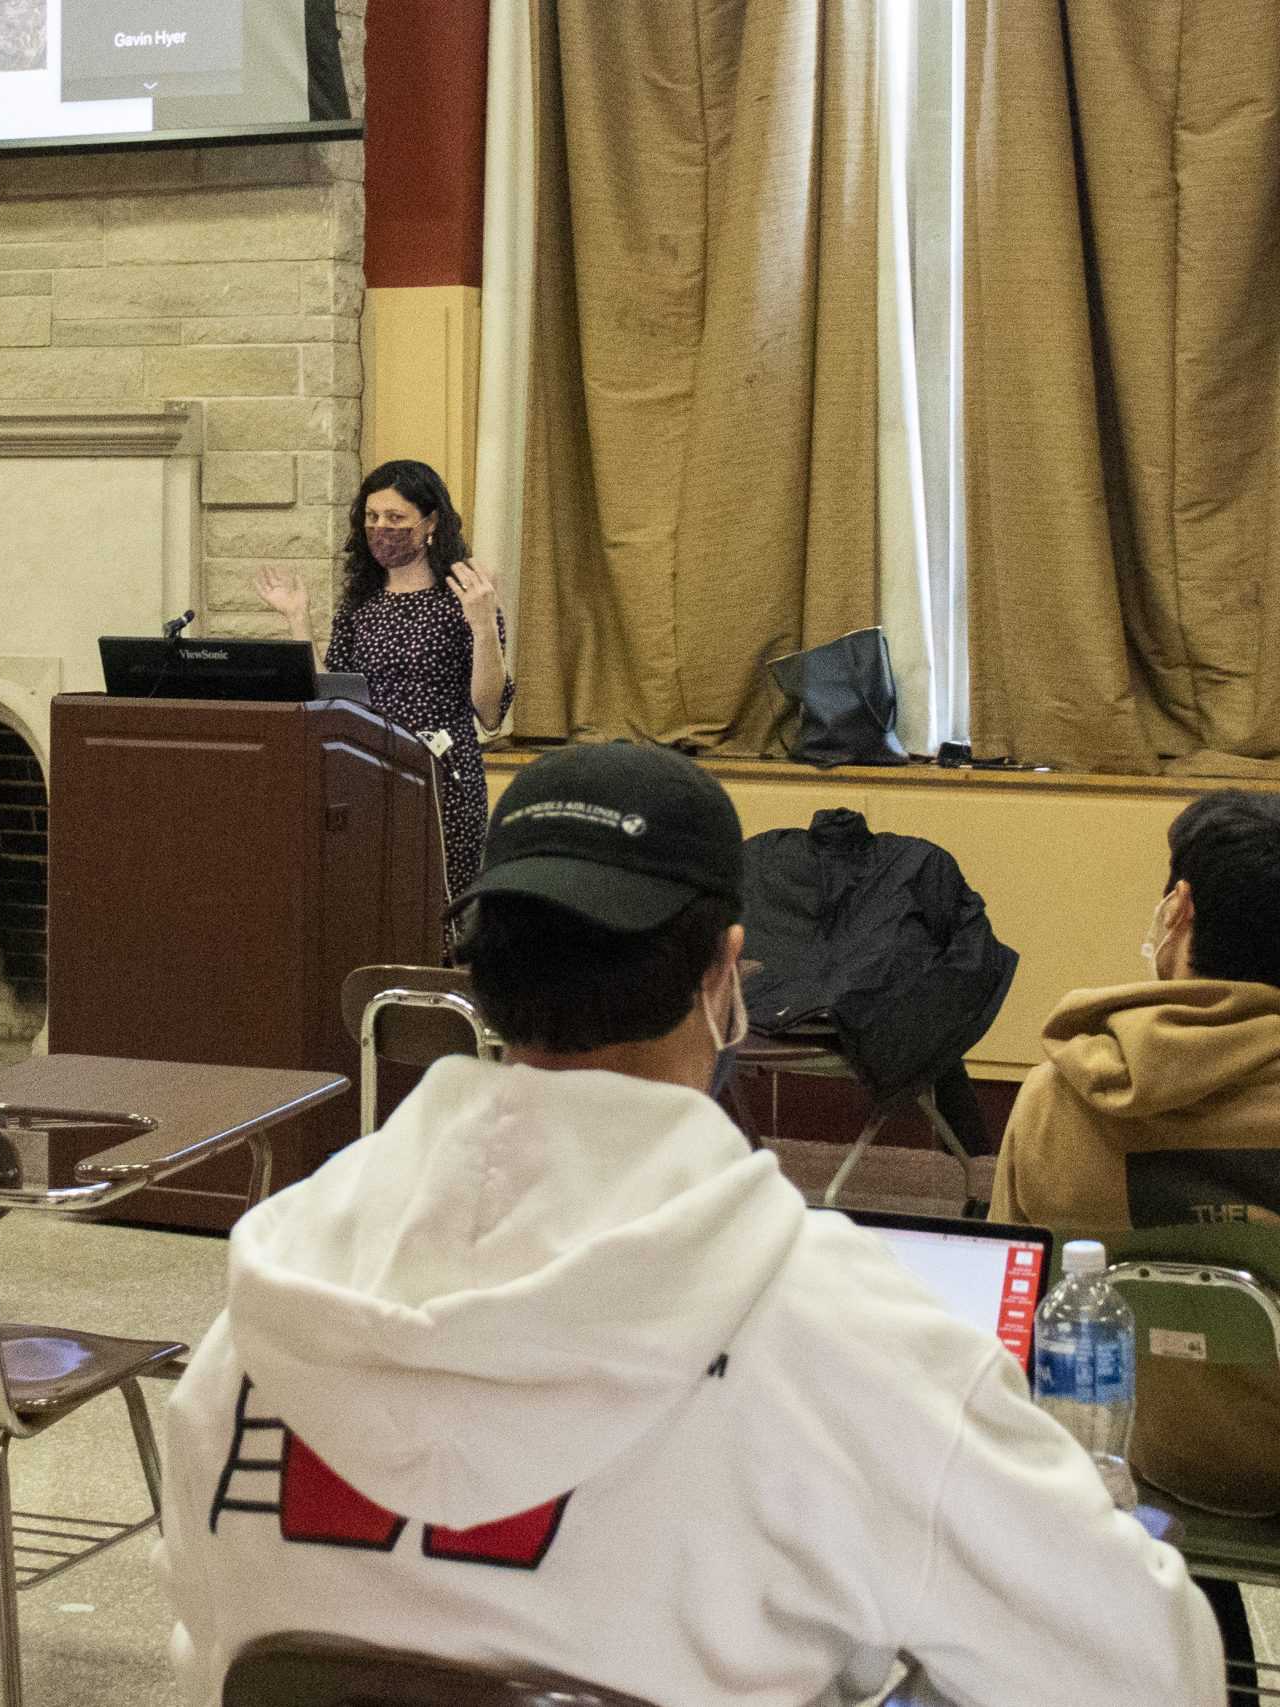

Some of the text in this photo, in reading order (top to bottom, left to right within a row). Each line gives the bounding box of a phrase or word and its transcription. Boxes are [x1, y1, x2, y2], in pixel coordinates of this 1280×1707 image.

[114, 30, 187, 47] Gavin Hyer
[179, 648, 229, 661] ViewSonic
